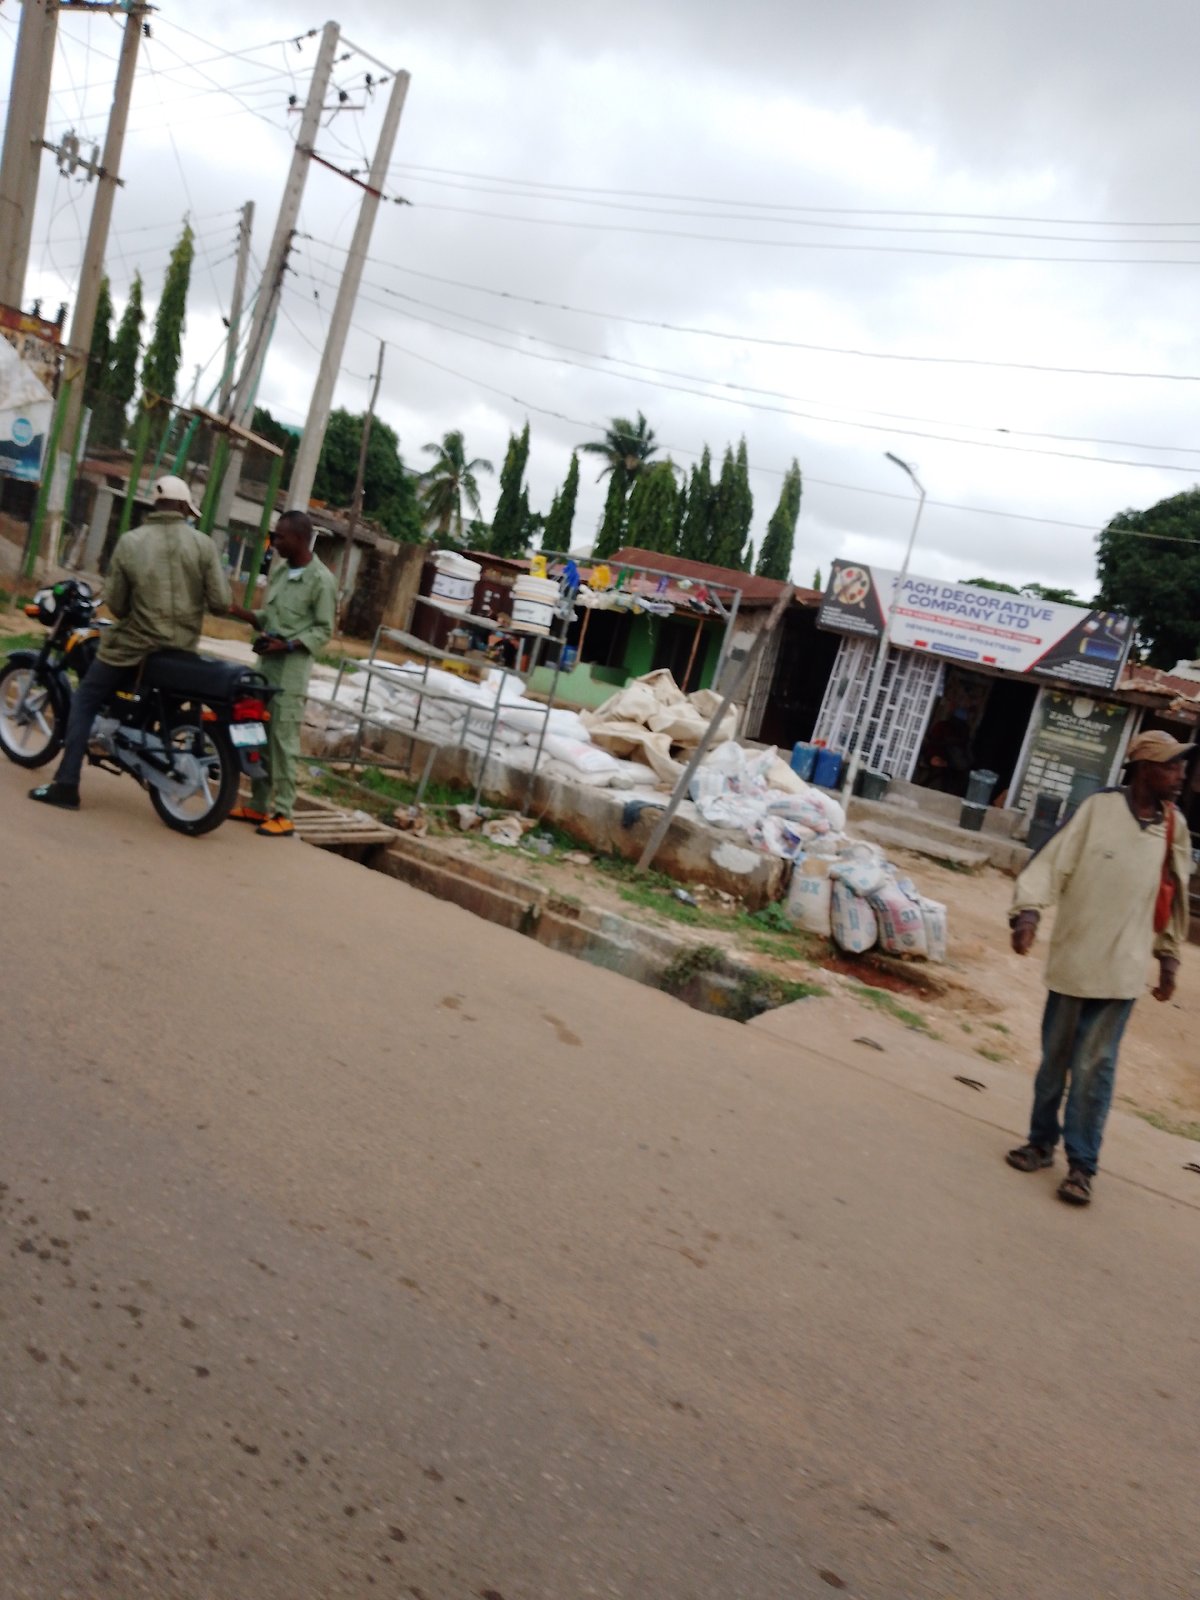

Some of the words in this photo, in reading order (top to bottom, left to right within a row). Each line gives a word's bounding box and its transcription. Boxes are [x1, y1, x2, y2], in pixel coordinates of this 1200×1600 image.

[907, 593, 994, 621] COMPANY
[997, 613, 1030, 629] LTD
[941, 587, 1054, 621] DECORATIVE
[1078, 717, 1112, 732] PAINT
